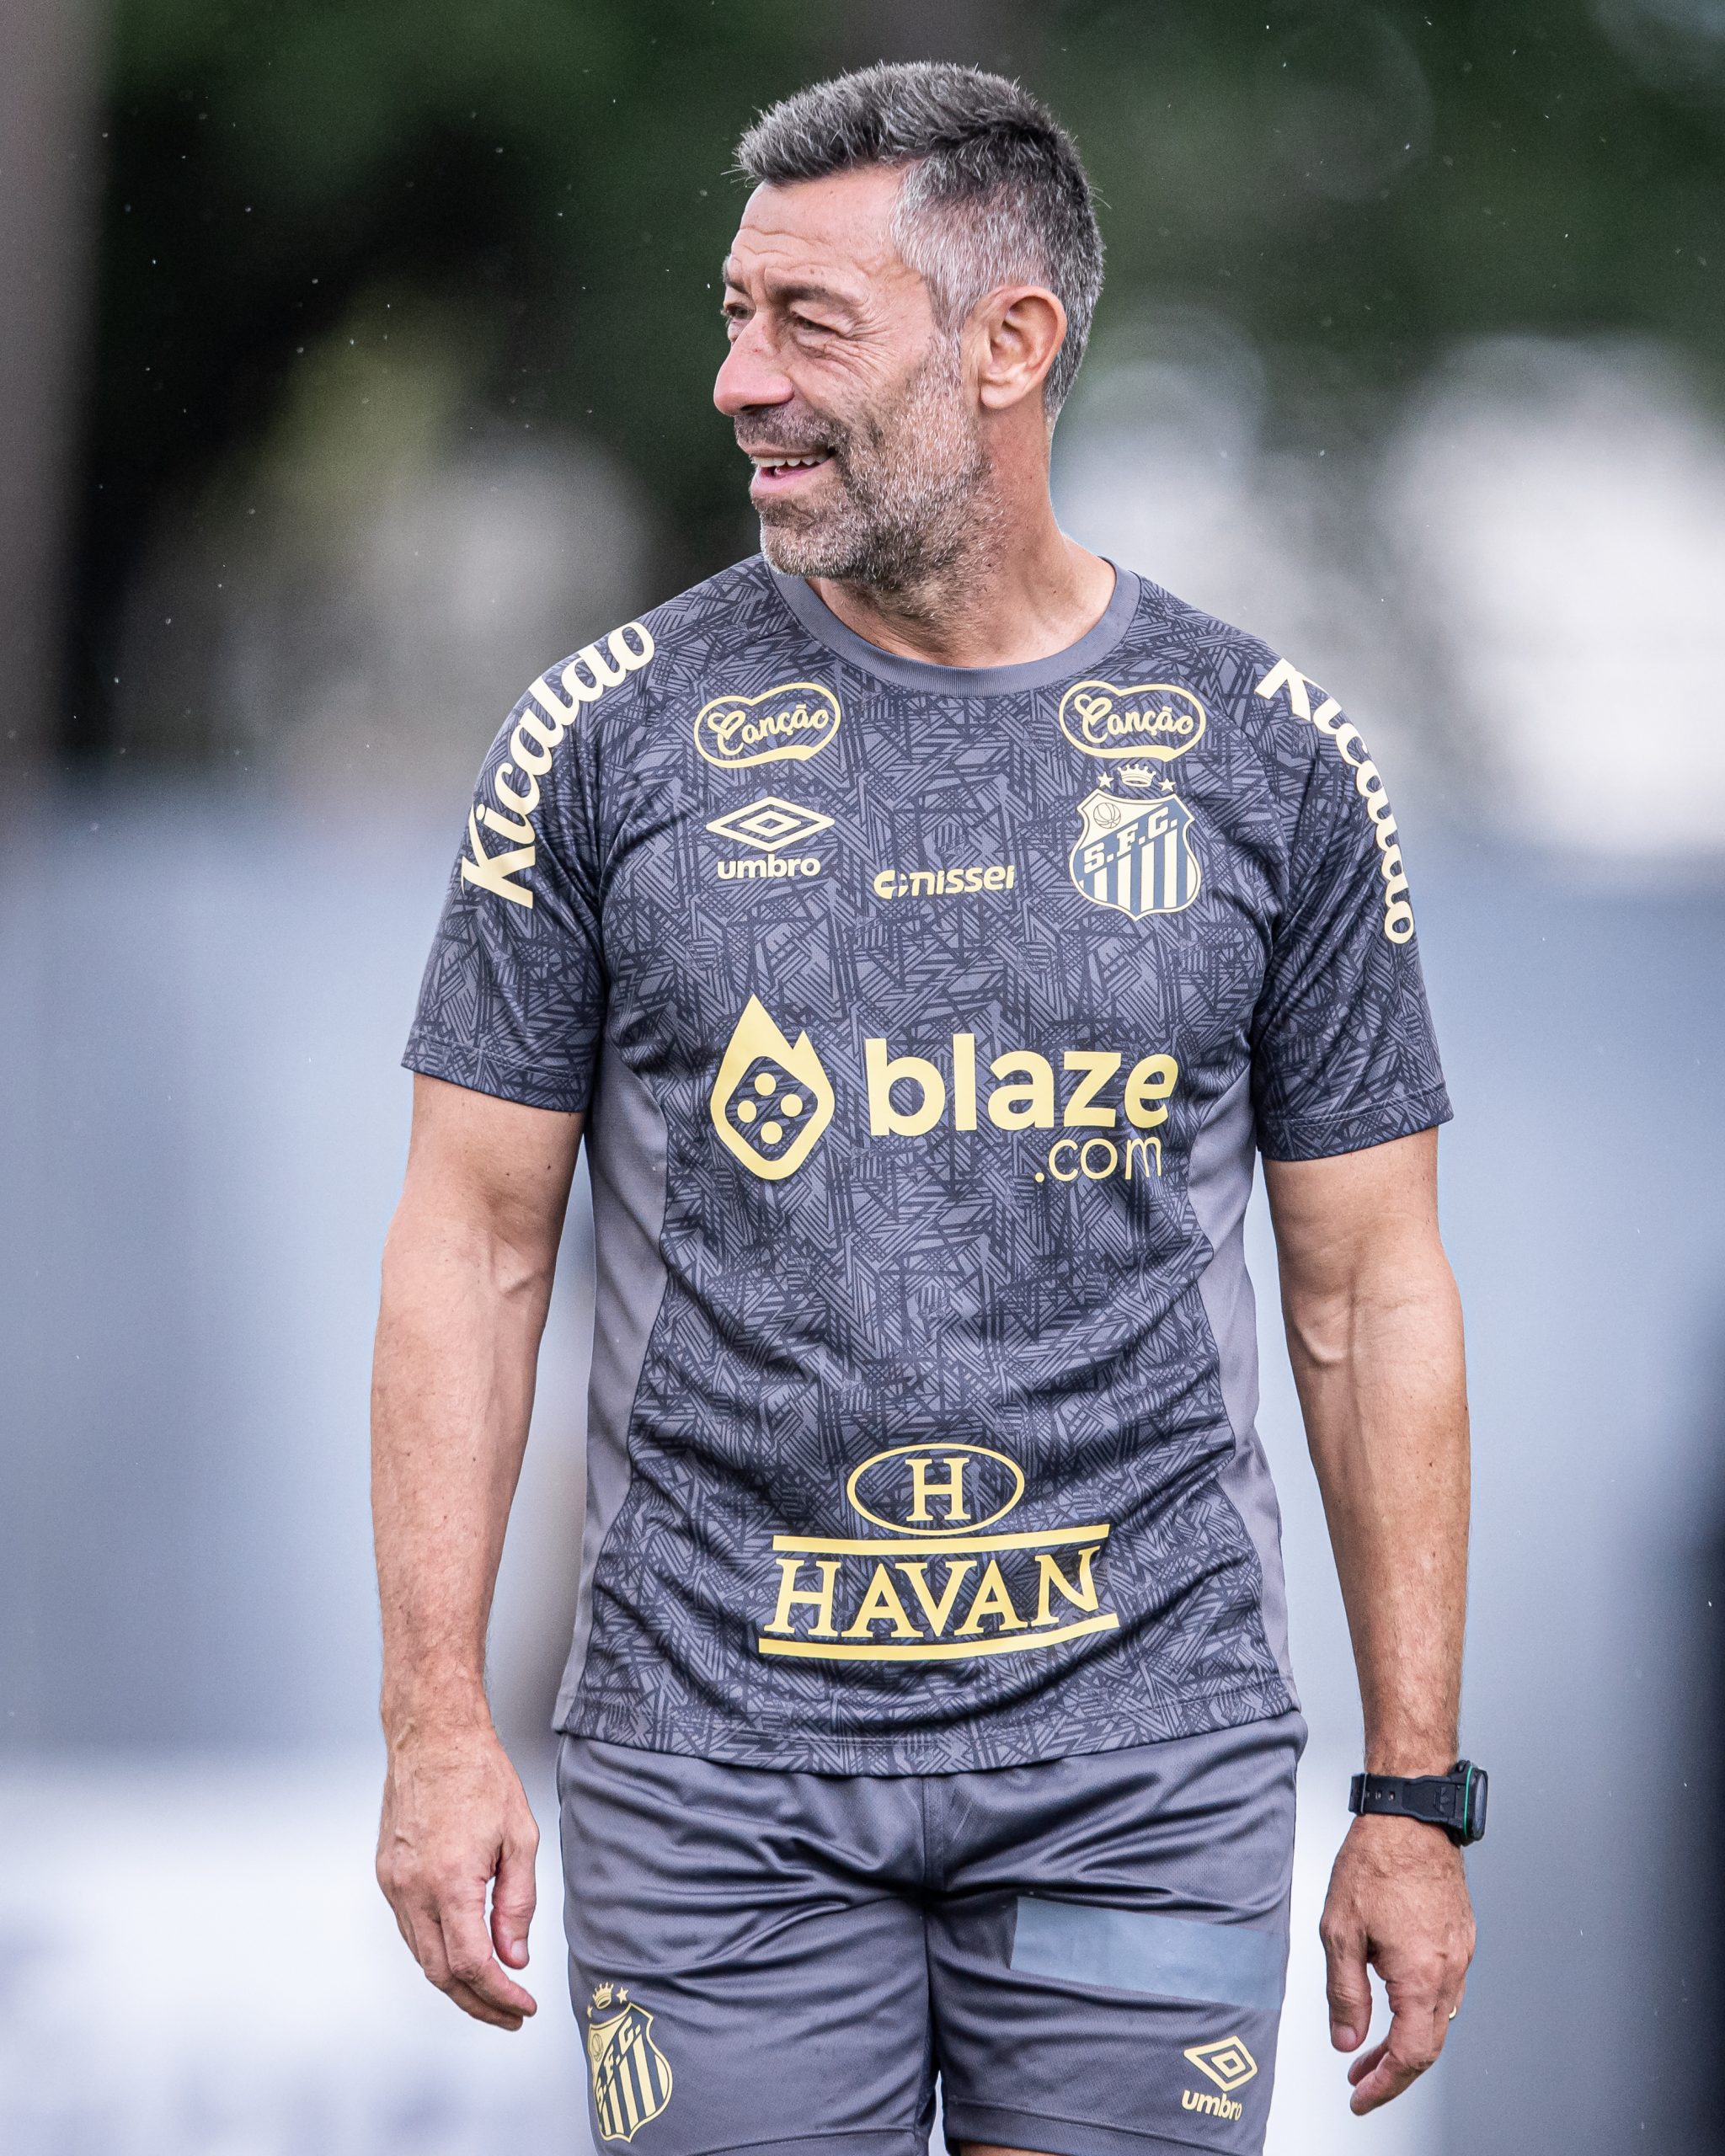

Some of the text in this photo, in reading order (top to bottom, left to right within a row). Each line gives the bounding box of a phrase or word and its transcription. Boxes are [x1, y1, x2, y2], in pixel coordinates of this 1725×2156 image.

[708, 704, 829, 755] Canção
[1073, 694, 1194, 743] Canção
[462, 622, 655, 909] Kicaldo
[717, 855, 820, 879] umbro
[865, 1033, 1178, 1137] blaze
[1035, 1137, 1162, 1182] .com
[905, 1458, 971, 1522] H
[764, 1545, 1101, 1638] HAVAN
[1182, 2089, 1242, 2121] umbro
